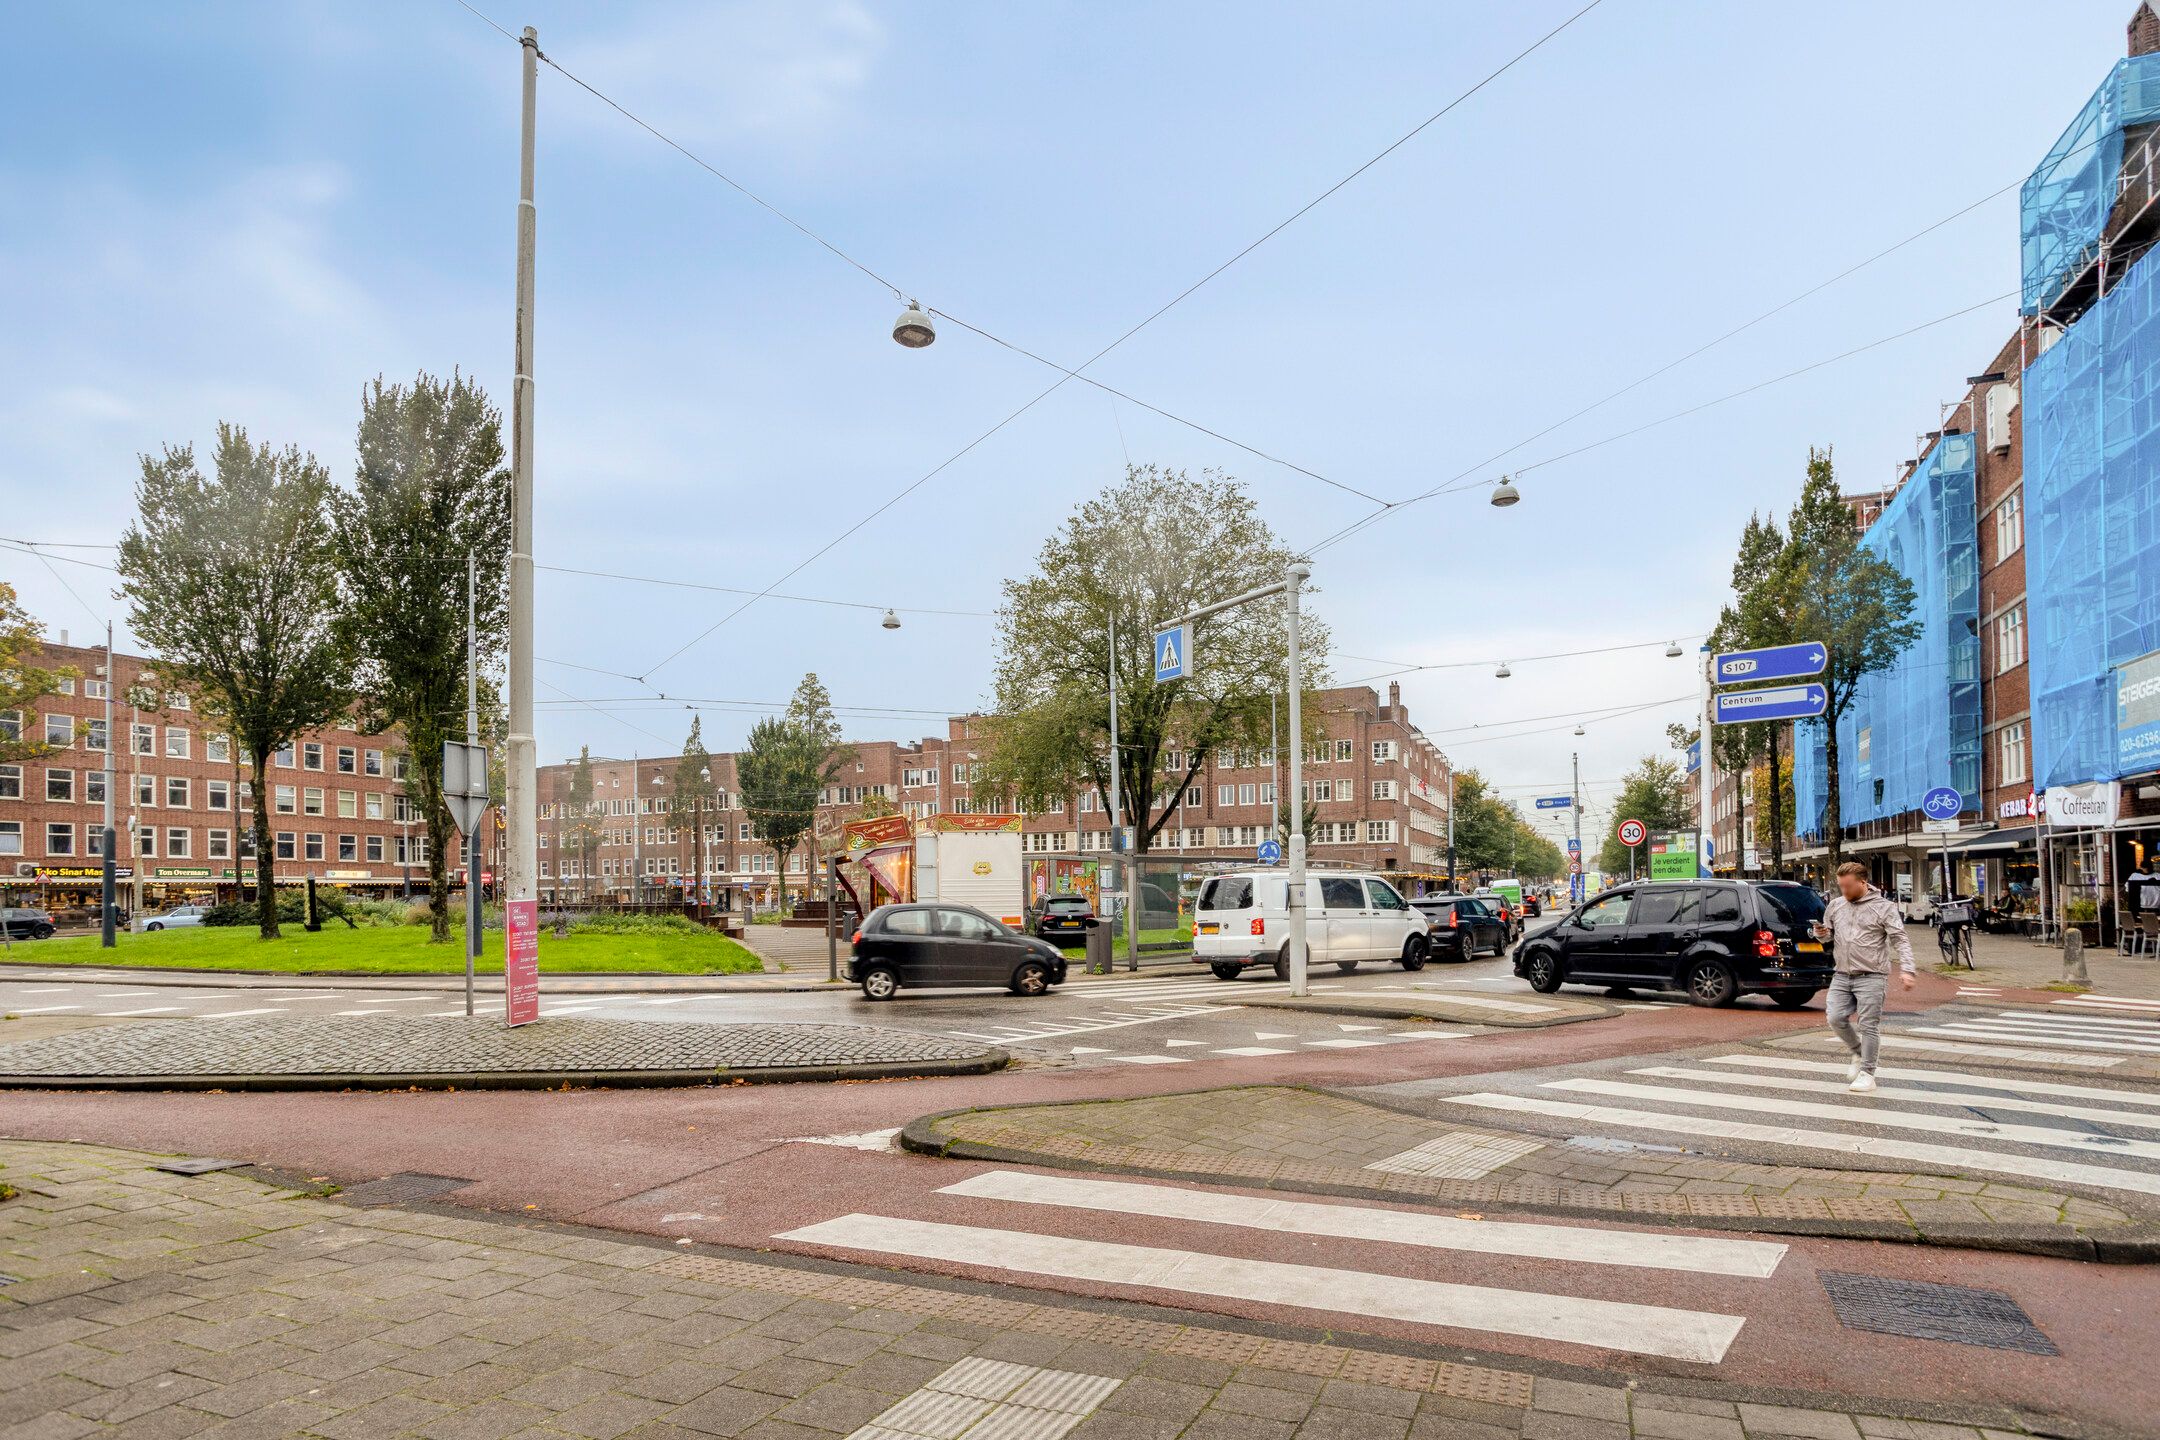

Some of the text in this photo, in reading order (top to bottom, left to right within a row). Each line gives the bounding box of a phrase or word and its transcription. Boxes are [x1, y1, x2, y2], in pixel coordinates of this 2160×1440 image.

[1722, 696, 1763, 706] Centrum
[2120, 730, 2160, 752] 020-62596
[2000, 799, 2027, 818] KEBAB
[1623, 828, 1641, 838] 30
[1662, 857, 1690, 865] verdient
[60, 868, 83, 876] Sinar
[84, 868, 103, 876] Mas
